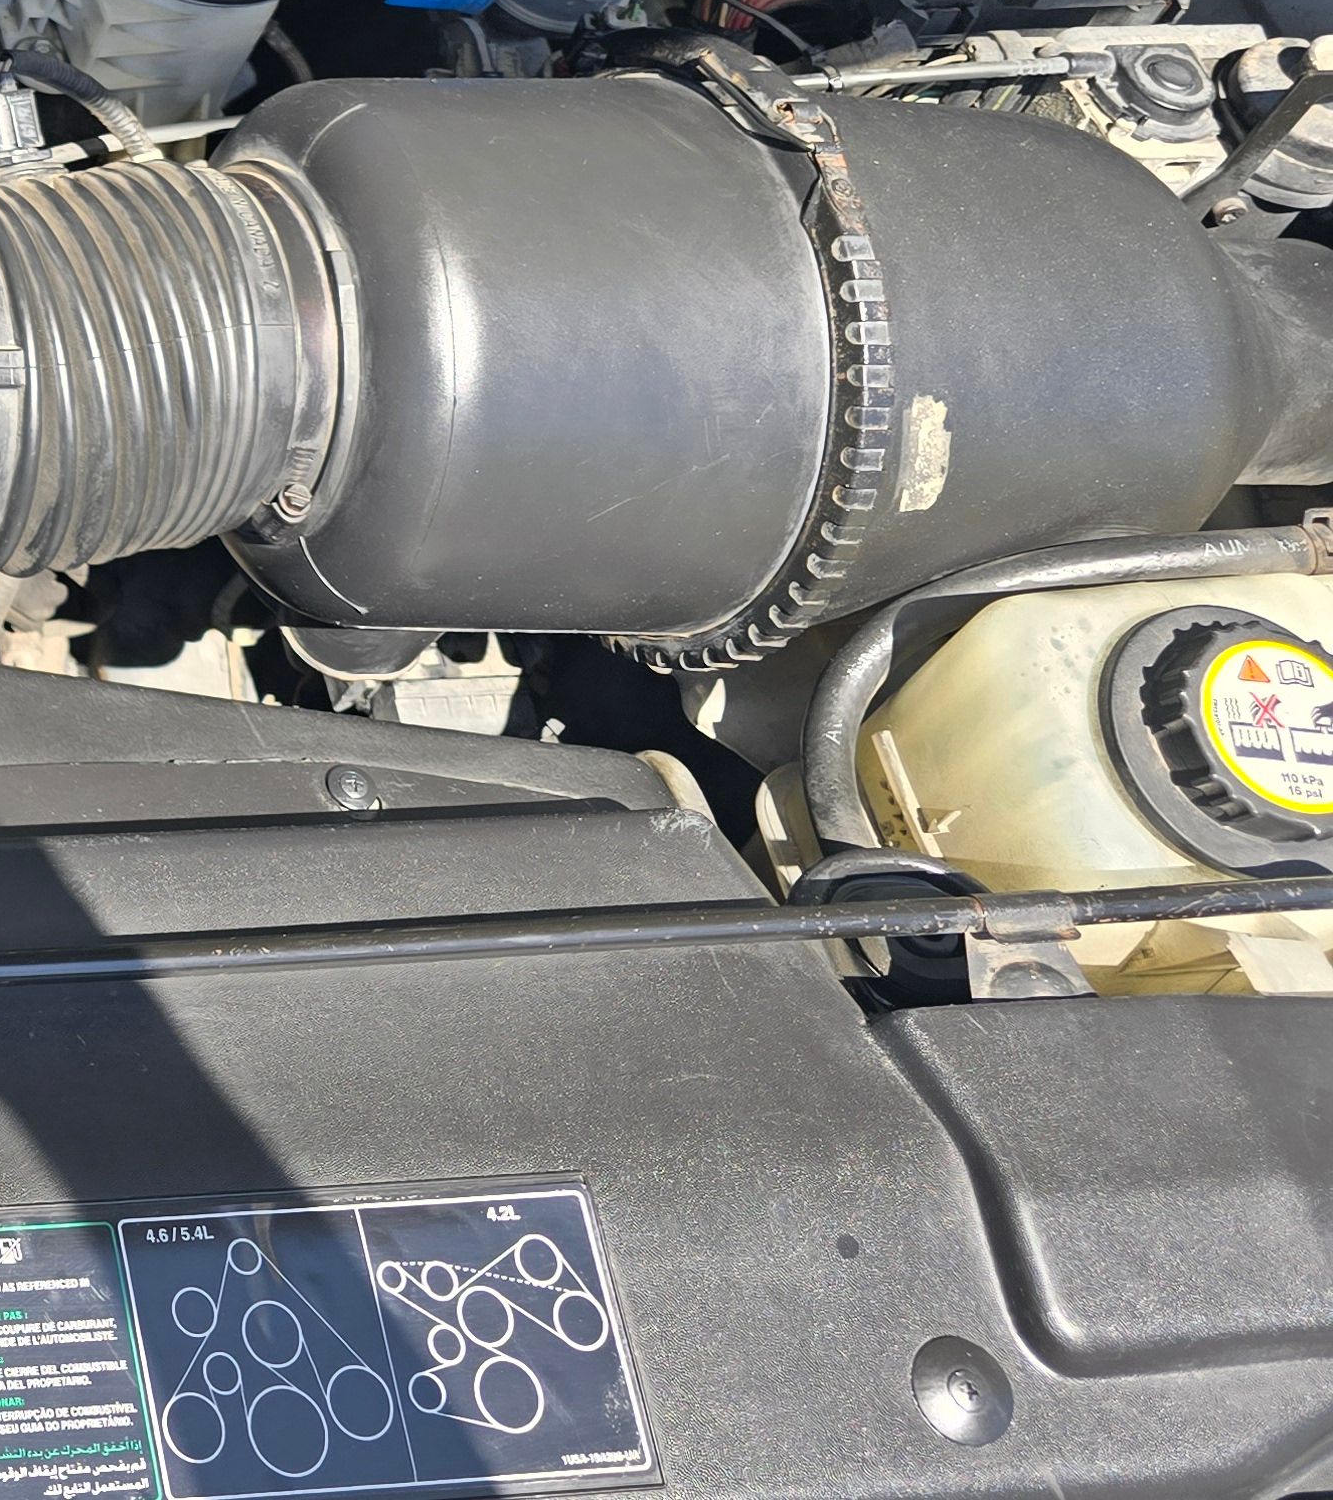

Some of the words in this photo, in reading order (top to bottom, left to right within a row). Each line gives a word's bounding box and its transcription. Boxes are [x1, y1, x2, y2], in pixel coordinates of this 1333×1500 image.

[238, 211, 276, 269] CANADA
[1281, 772, 1299, 783] 110
[1303, 774, 1324, 786] kPa
[1306, 788, 1323, 799] psi
[486, 1204, 522, 1222] 4.2L
[146, 1228, 168, 1243] 4.6
[180, 1225, 215, 1240] 5.4L
